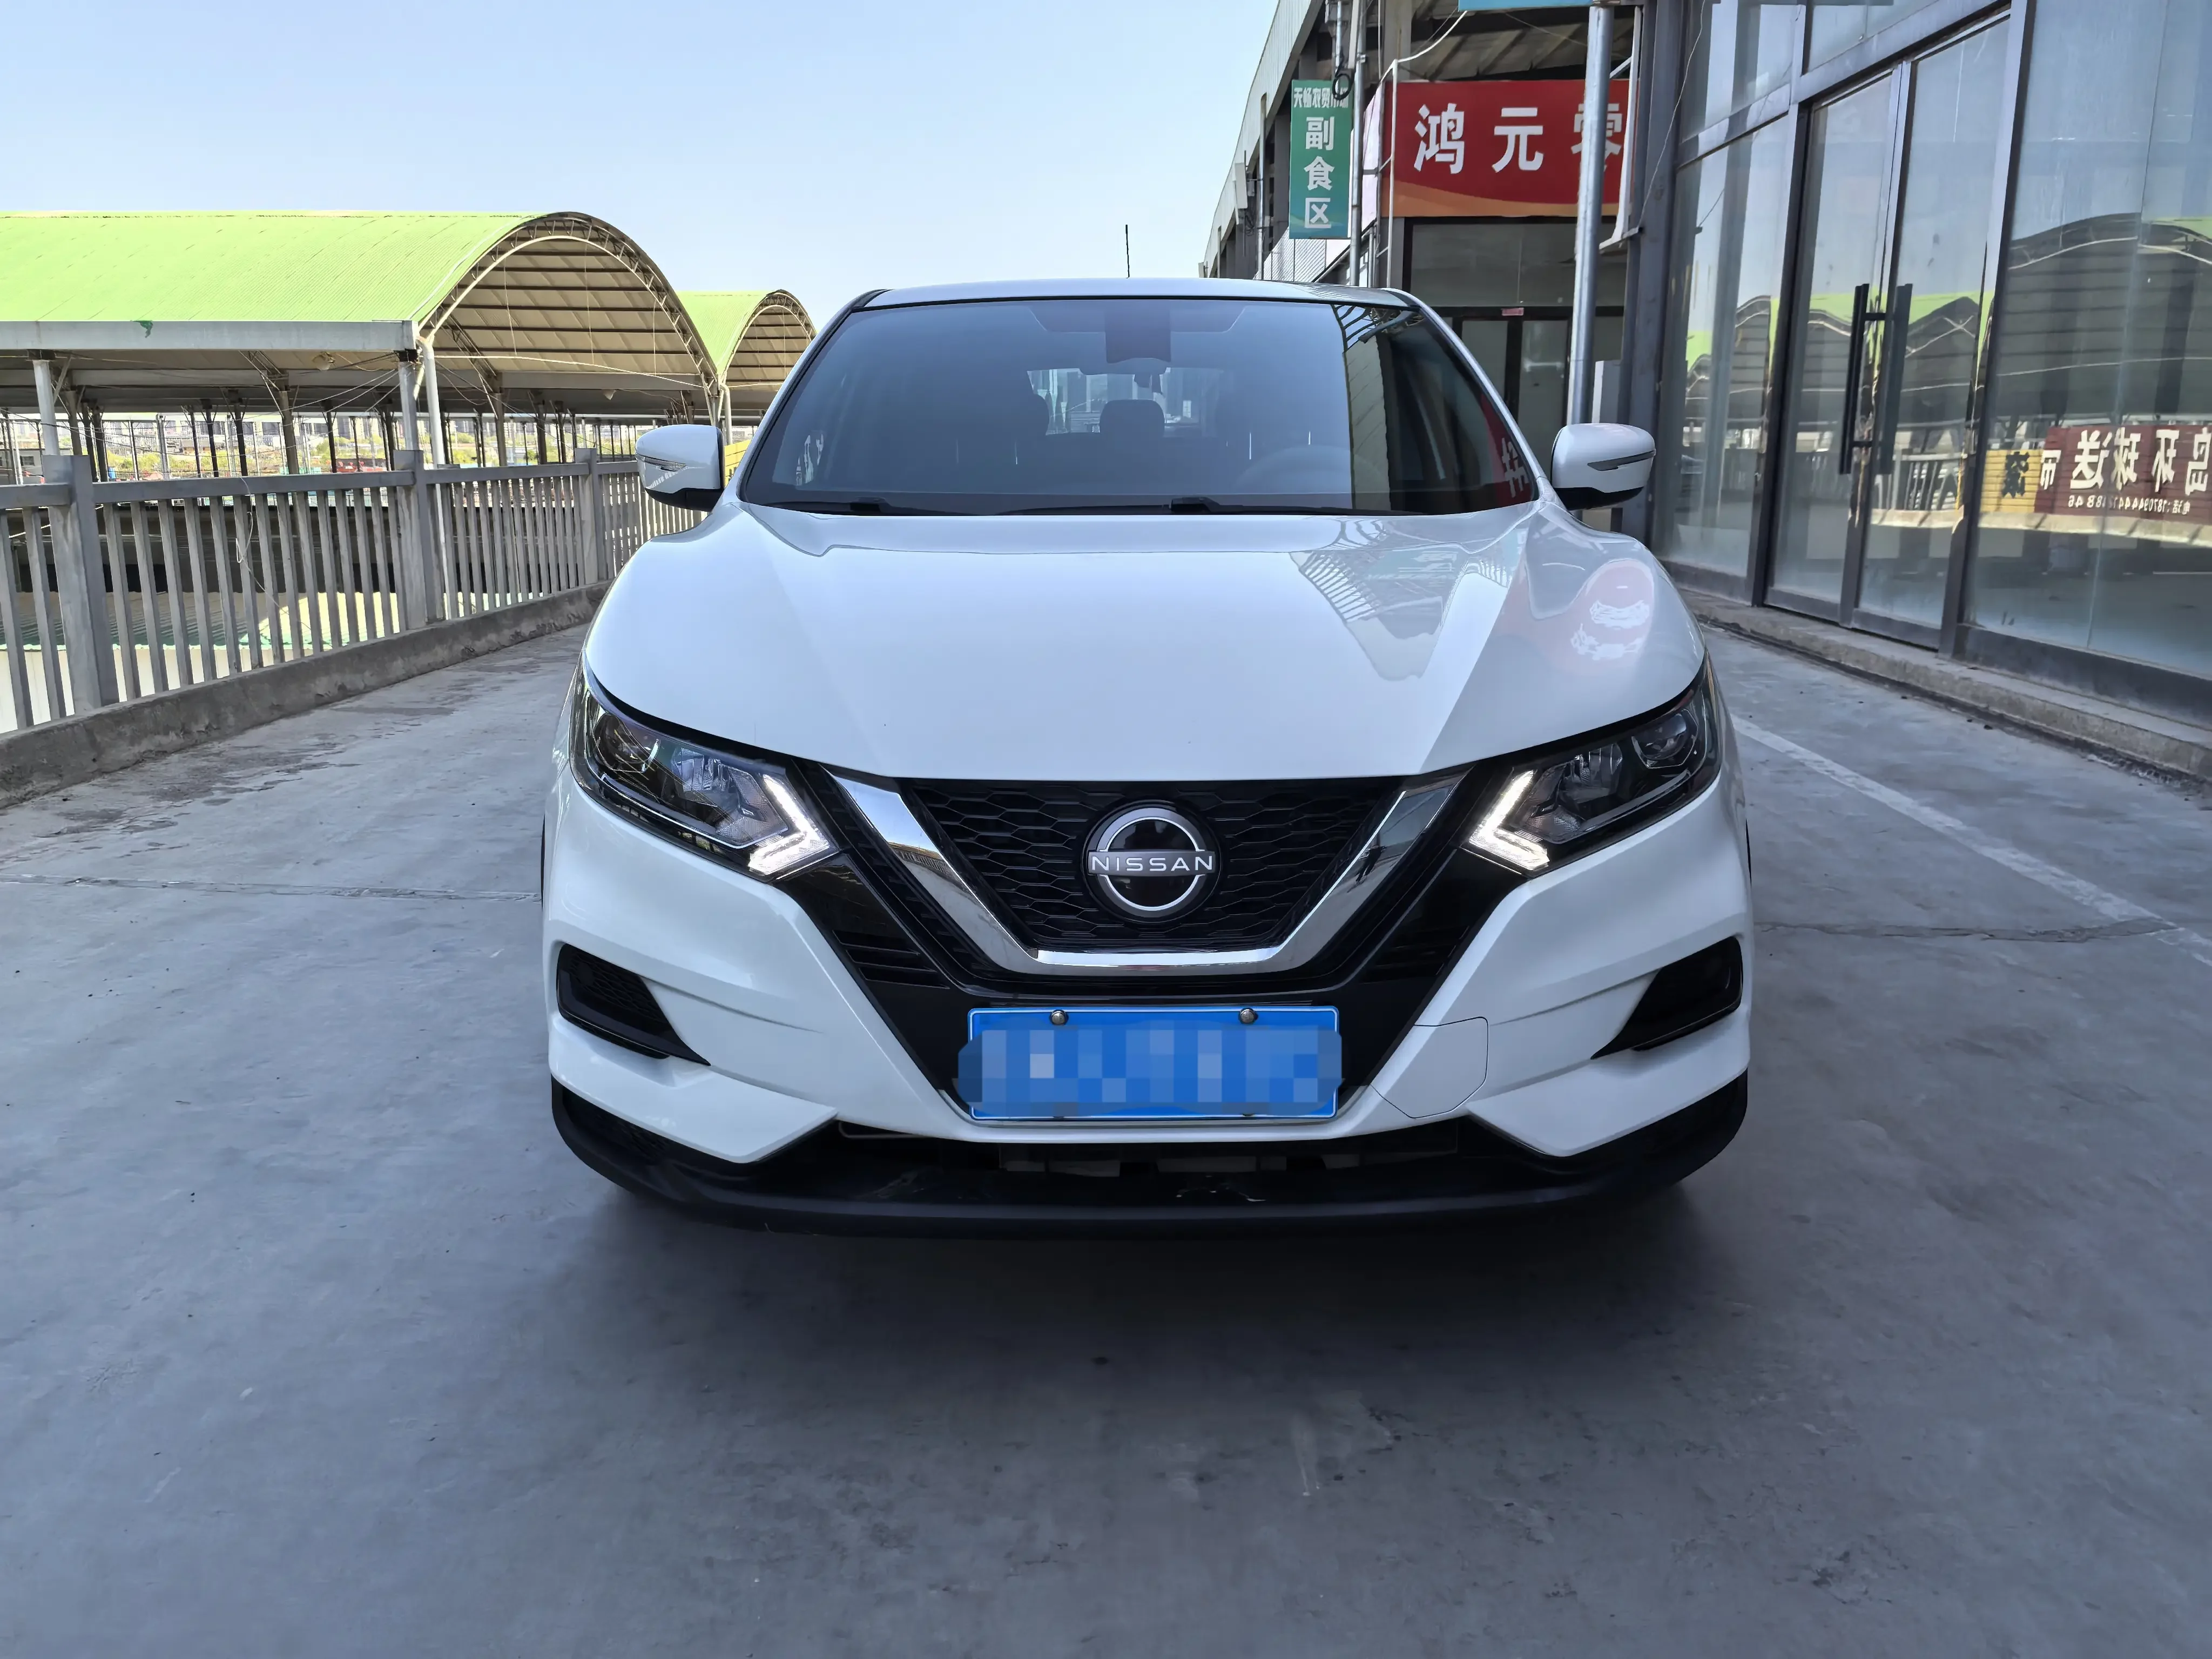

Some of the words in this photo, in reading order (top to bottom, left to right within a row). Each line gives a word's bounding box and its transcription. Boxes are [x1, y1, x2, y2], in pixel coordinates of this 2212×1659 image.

[1303, 116, 1335, 229] 副食区
[1091, 855, 1213, 872] NISSAN
